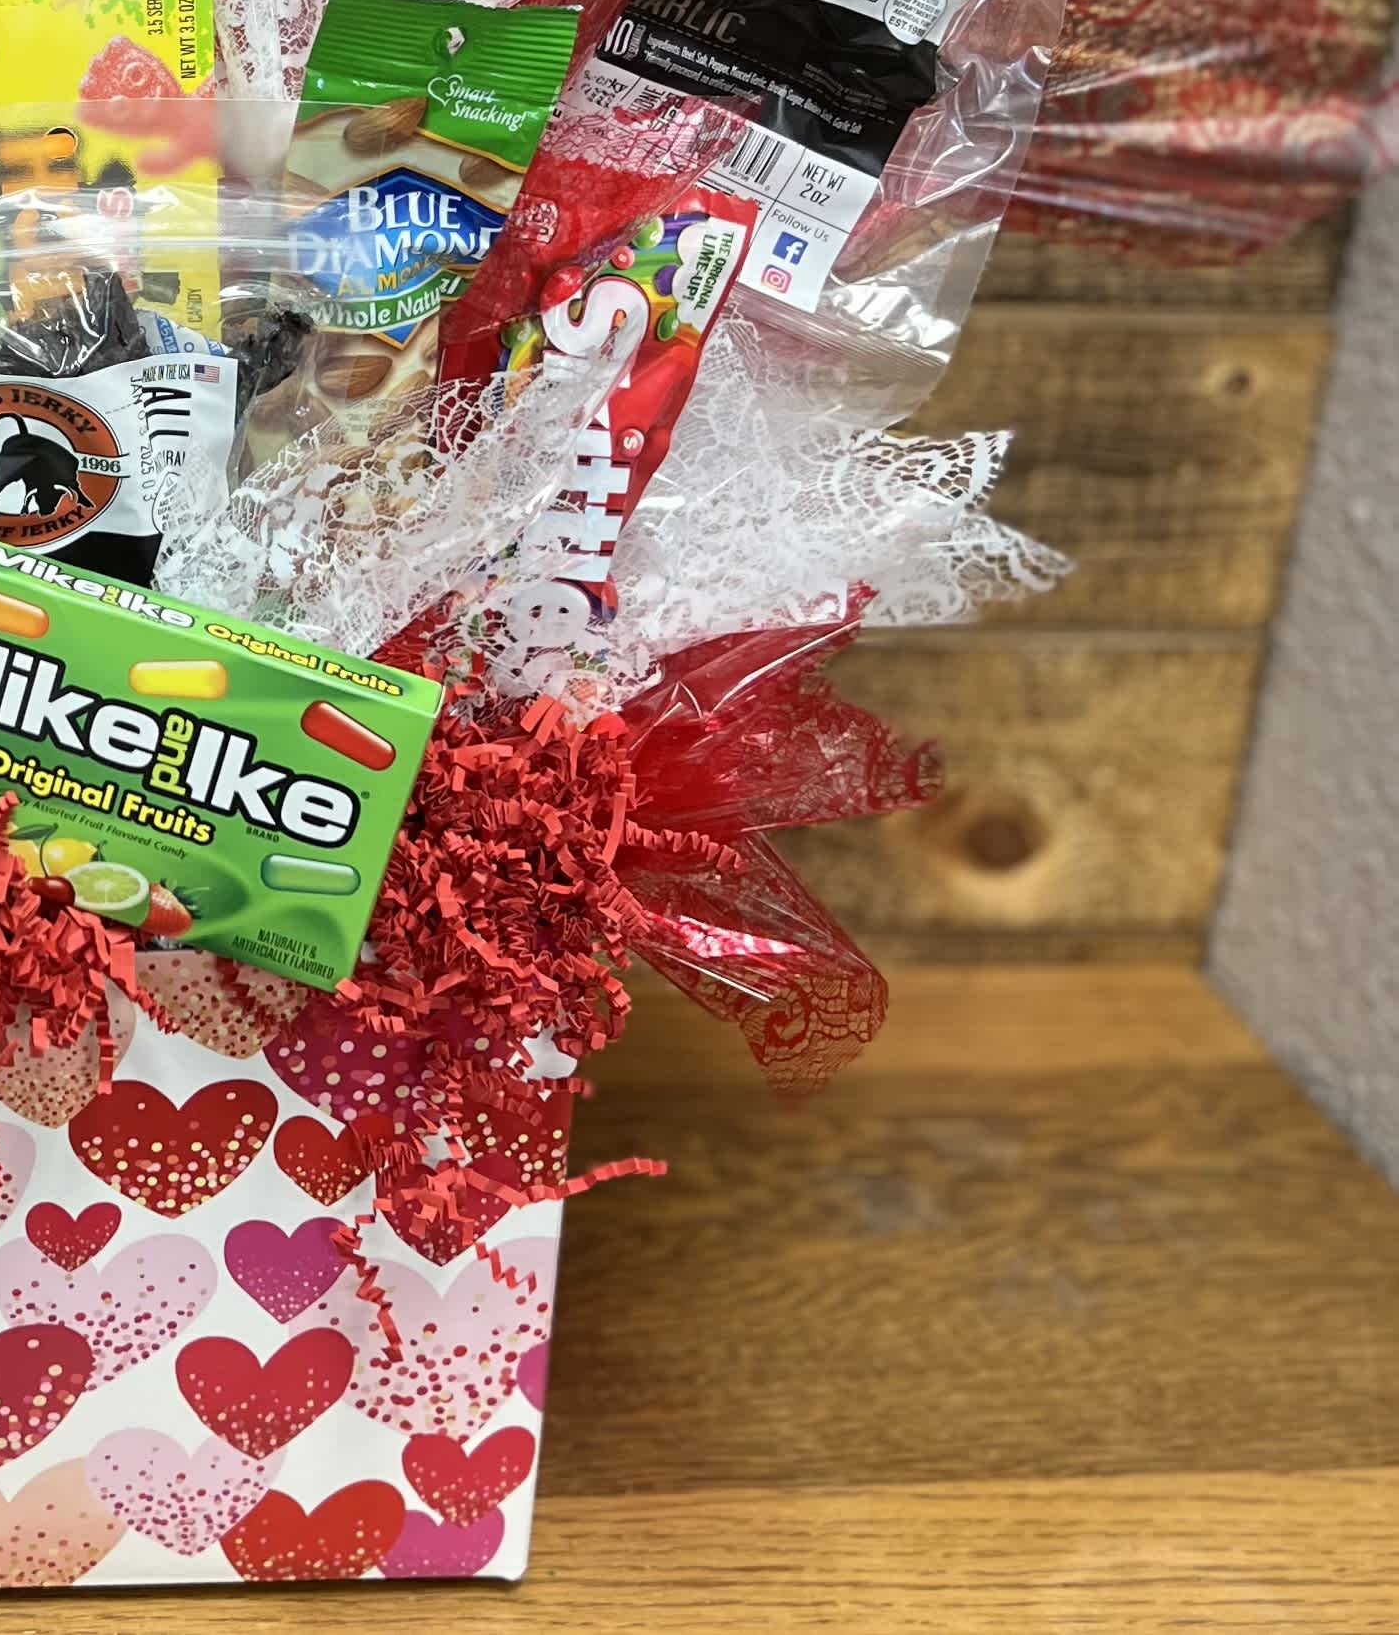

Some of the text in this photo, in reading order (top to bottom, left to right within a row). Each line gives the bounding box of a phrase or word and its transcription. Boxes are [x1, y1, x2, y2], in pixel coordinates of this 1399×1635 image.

[147, 19, 163, 36] 3.5
[179, 15, 195, 33] 3.5
[180, 36, 196, 56] WT
[180, 59, 196, 79] NET
[445, 80, 497, 102] Smart
[451, 99, 527, 132] Snacking!
[802, 162, 847, 192] NET WT
[348, 186, 461, 232] BLUE
[800, 183, 830, 206] 2 OZ
[772, 209, 830, 242] Follow Us
[682, 234, 717, 301] LIME-UP!
[693, 232, 734, 310] THE ORIGINAL
[311, 297, 390, 328] Whole
[142, 365, 190, 382] MADE IN THE USA
[11, 387, 98, 434] JERKY
[131, 376, 154, 475] JAN 2025
[142, 387, 191, 452] ALL
[79, 455, 122, 474] 1996
[21, 507, 86, 540] JERKY
[118, 593, 194, 629] Ike
[205, 623, 403, 697] Original Fruits
[148, 712, 195, 797] and
[187, 725, 355, 845] Ike
[32, 799, 188, 860] Assorted Fruit Flavored Candy
[121, 791, 213, 843] Fruits
[245, 826, 280, 844] BRAND
[232, 935, 334, 979] ARTIFICIALLY FLAVORED
[257, 929, 317, 959] NATURALLY &
